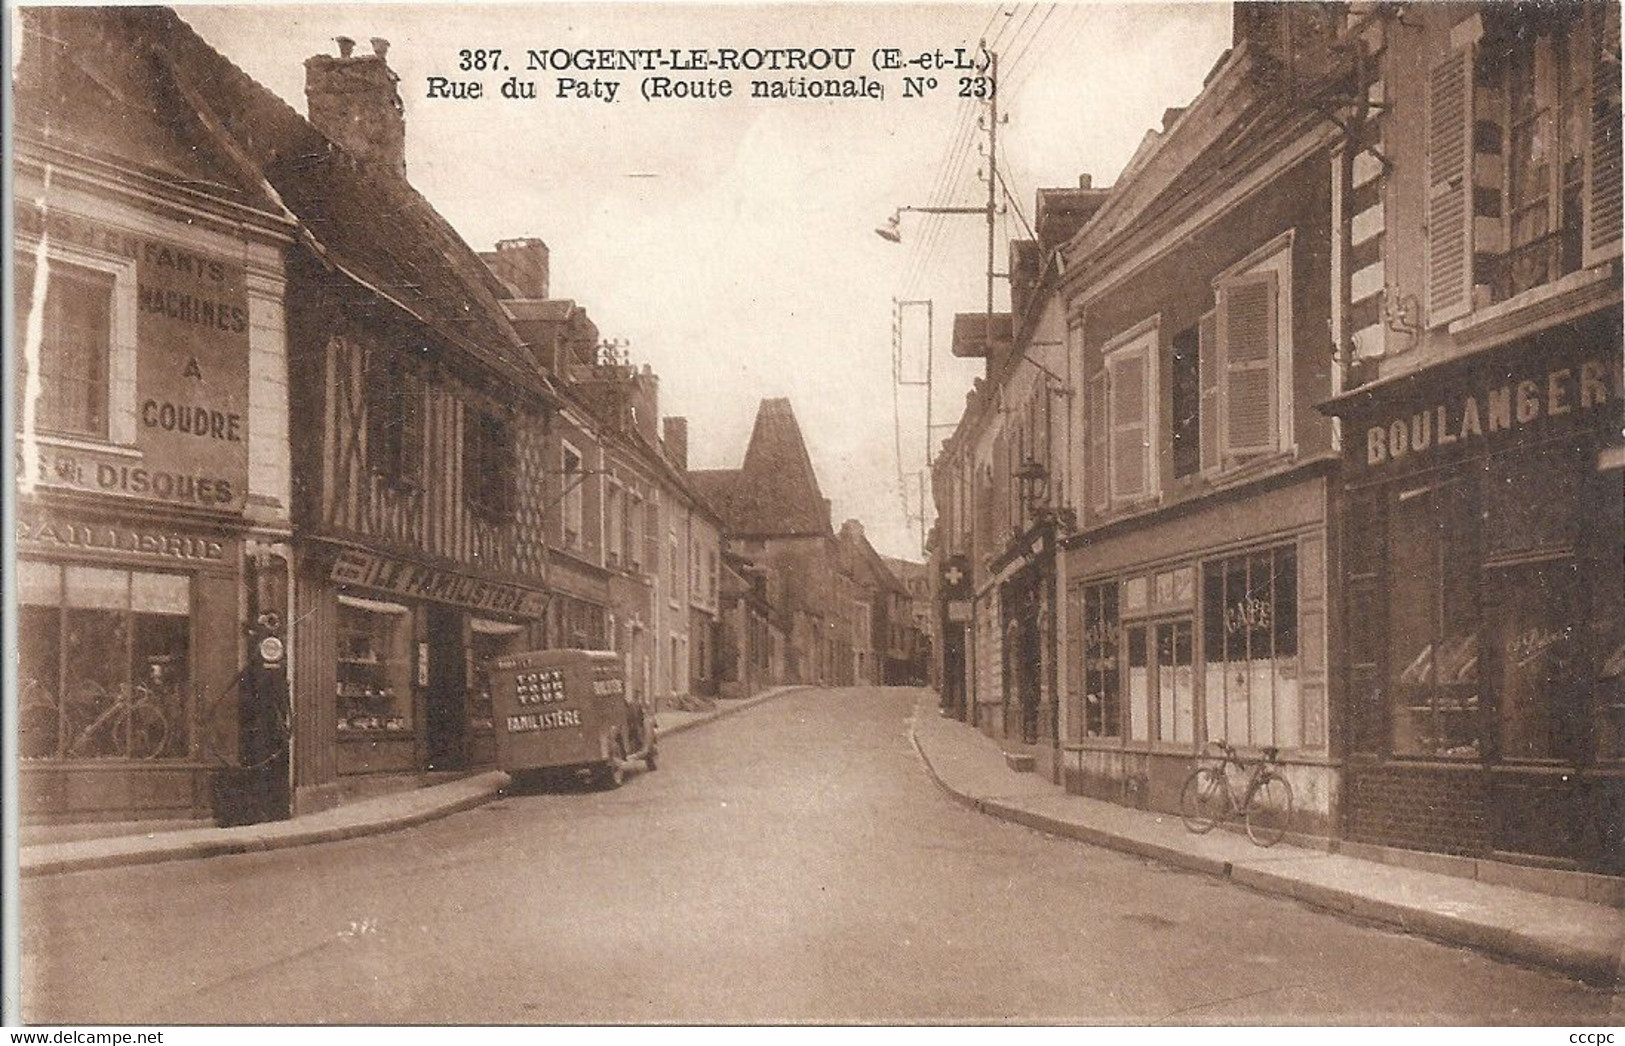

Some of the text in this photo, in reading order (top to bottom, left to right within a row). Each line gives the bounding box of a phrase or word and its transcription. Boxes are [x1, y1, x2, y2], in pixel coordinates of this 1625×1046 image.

[182, 356, 202, 380] A
[142, 398, 242, 442] COUDRE
[96, 462, 233, 503] DISQUES
[517, 670, 562, 685] TOUT
[519, 691, 564, 704] TOUS
